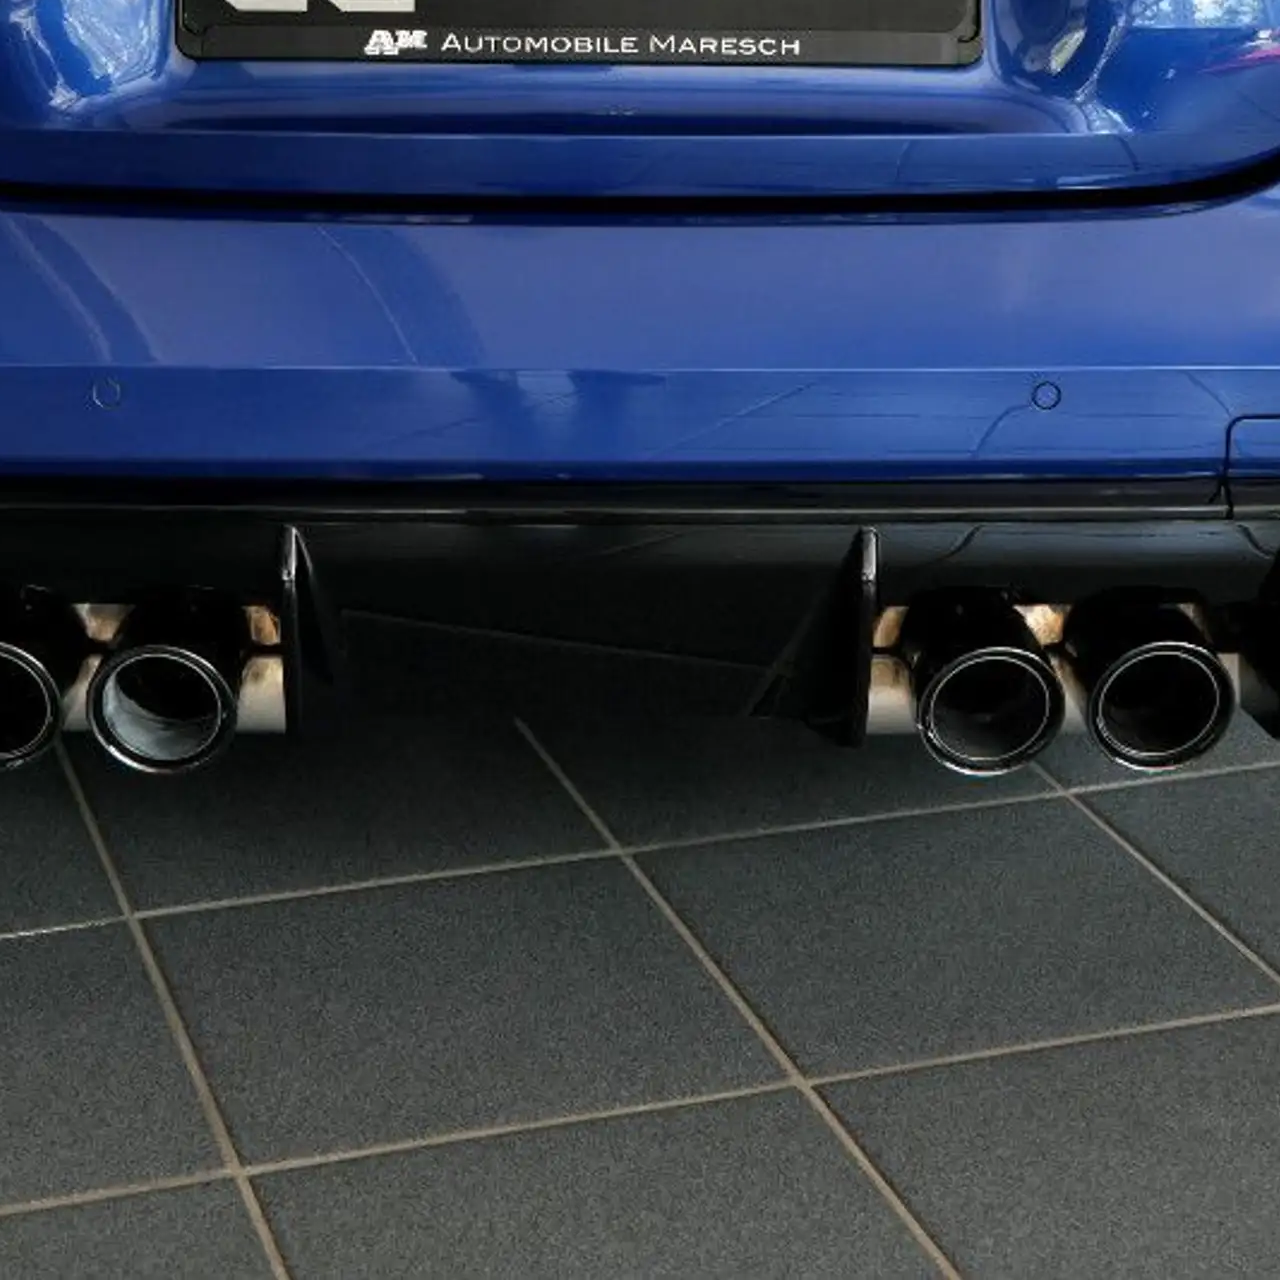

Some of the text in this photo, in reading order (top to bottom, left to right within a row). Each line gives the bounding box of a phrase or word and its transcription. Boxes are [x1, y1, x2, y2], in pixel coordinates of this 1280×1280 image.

[364, 30, 801, 56] AM AUTOMOBILE MARESCH
